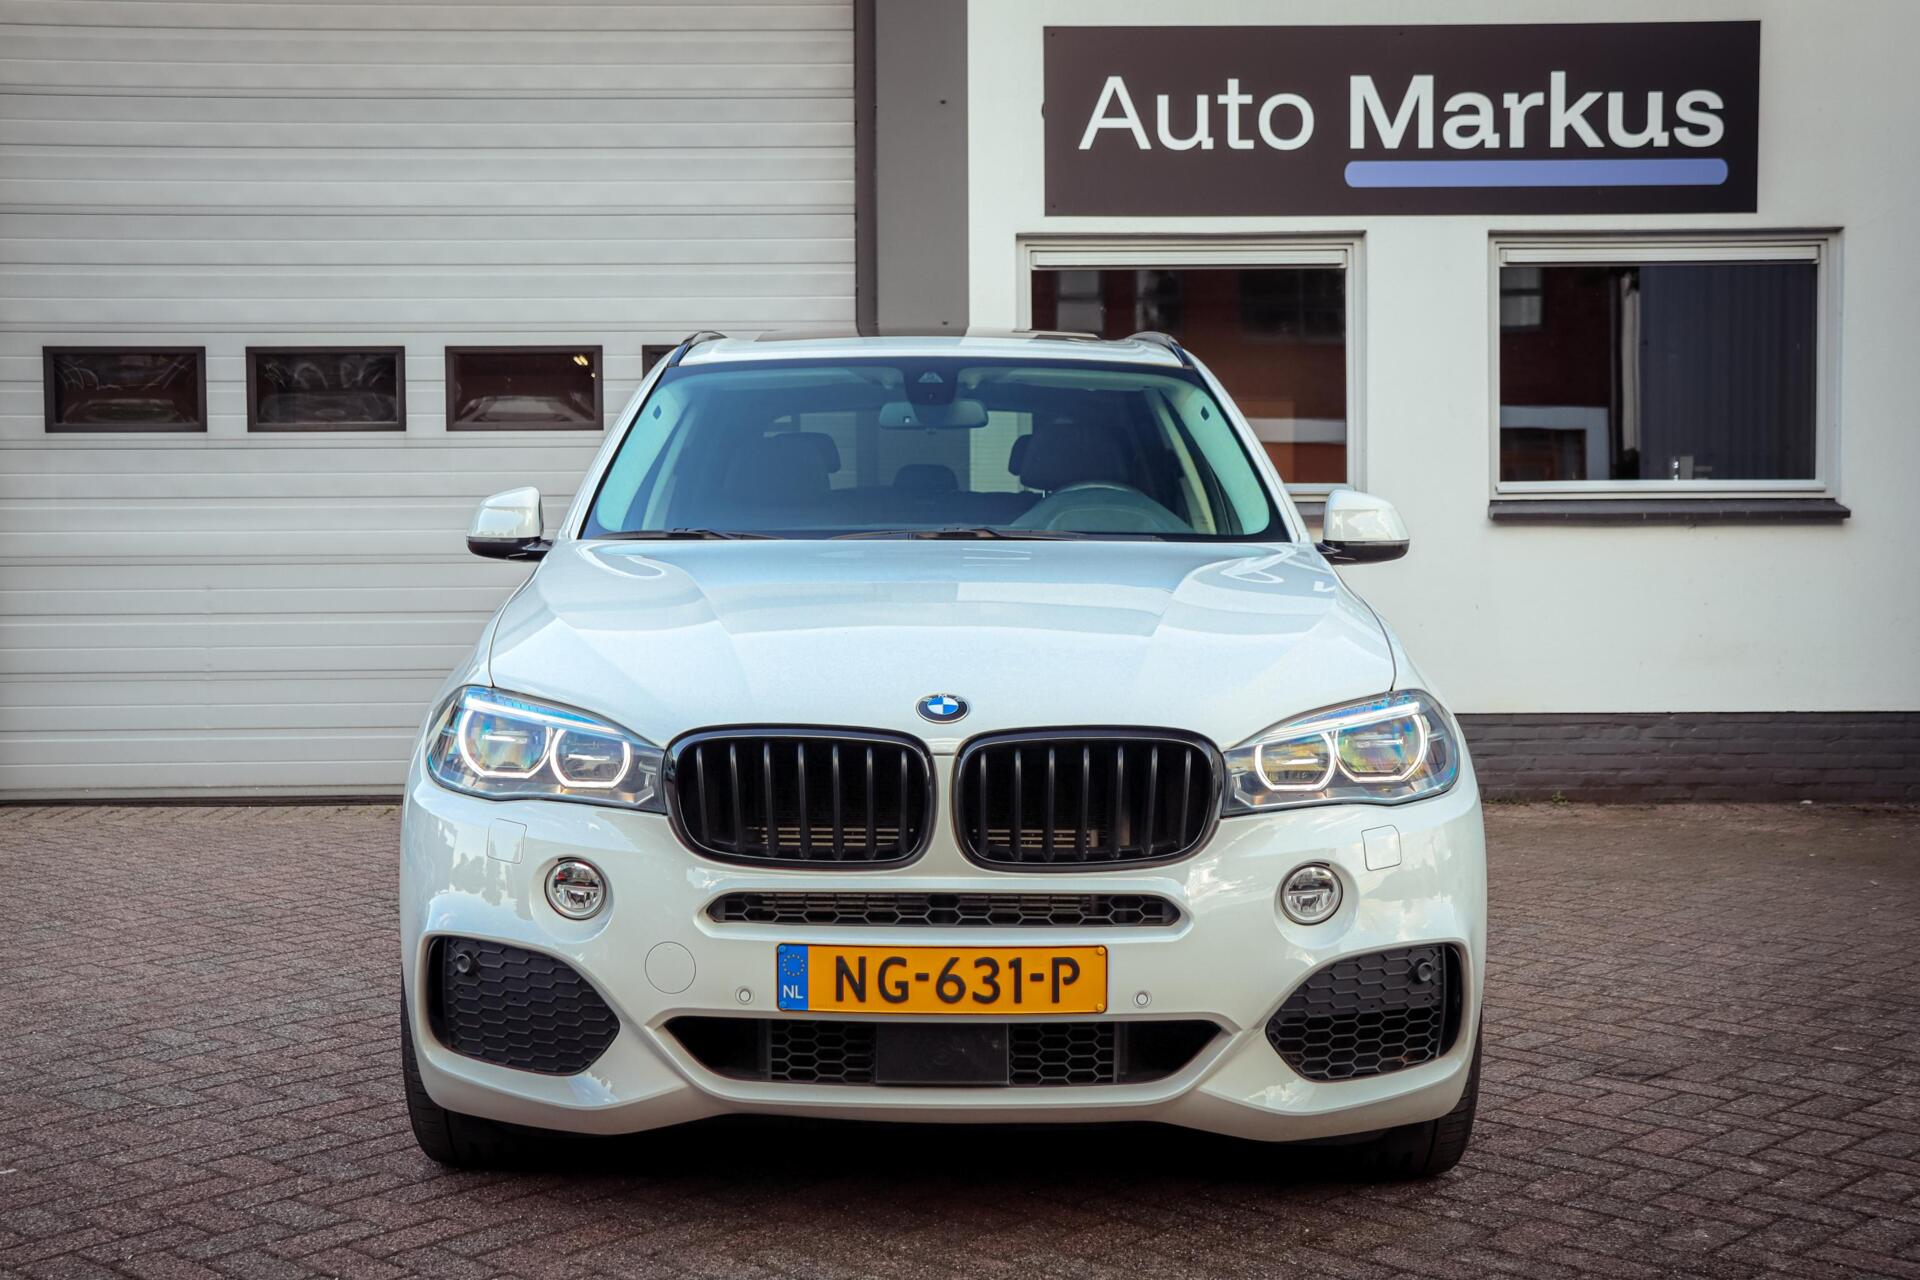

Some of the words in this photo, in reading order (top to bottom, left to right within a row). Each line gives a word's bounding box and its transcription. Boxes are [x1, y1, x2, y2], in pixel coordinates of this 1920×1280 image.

[1078, 76, 1315, 151] Auto
[1350, 71, 1725, 150] Markus
[782, 984, 804, 999] NL
[834, 955, 1081, 1005] NG-631-P
